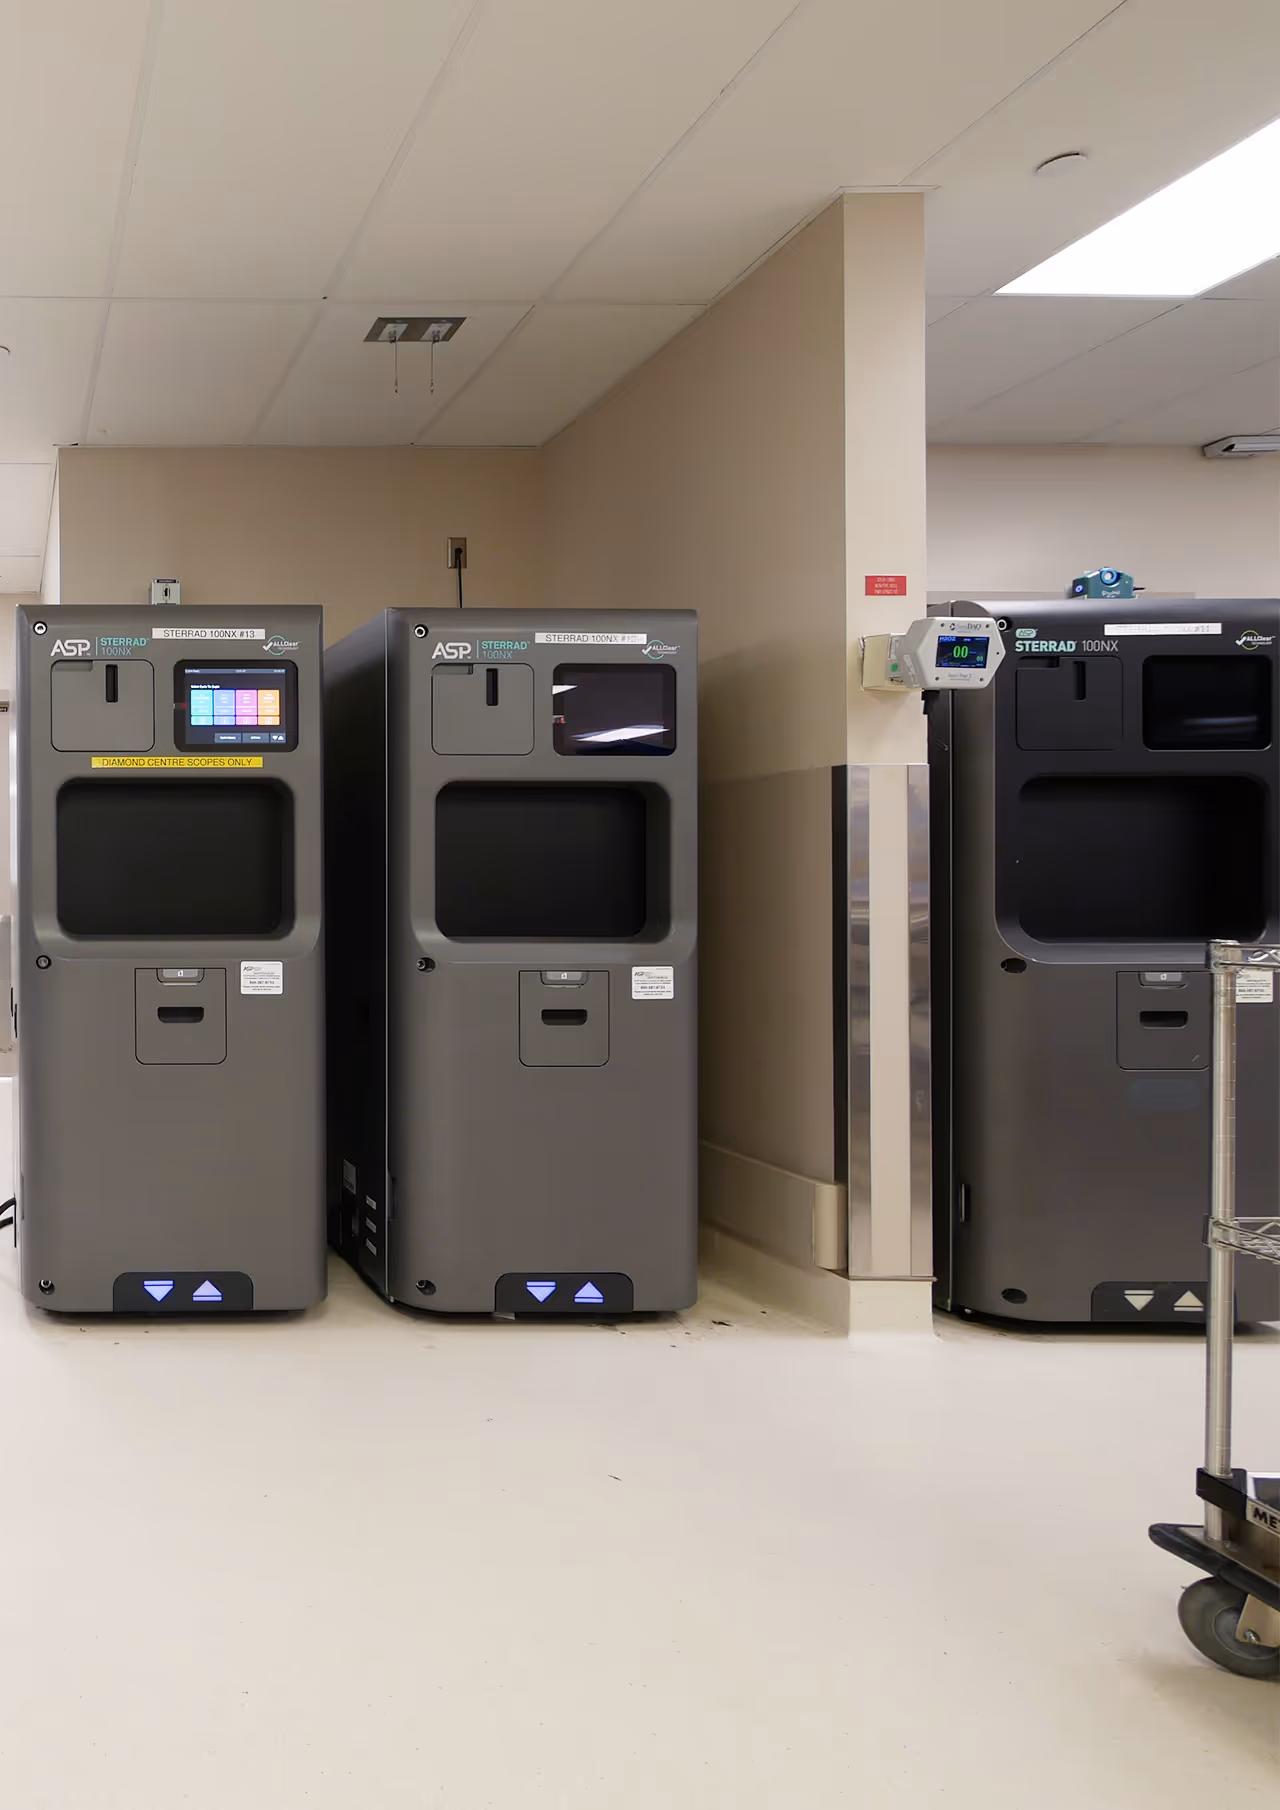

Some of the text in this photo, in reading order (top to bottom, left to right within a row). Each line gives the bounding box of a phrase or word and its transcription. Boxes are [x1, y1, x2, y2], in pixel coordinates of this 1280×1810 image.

[163, 629, 255, 638] STERRAD 100NX #13
[545, 634, 589, 642] STERRAD
[591, 634, 619, 643] 100NX
[100, 637, 147, 646] STERRAD
[481, 640, 528, 650] STERRAD
[1015, 639, 1119, 652] STERRAD 100NX
[50, 639, 90, 656] ASP
[101, 646, 132, 656] 100NX
[431, 642, 472, 659] ASP
[482, 650, 513, 659] 100NX
[102, 758, 253, 767] DIAMOND CENTRE SCOPES ONLY
[1252, 1506, 1280, 1530] ME
